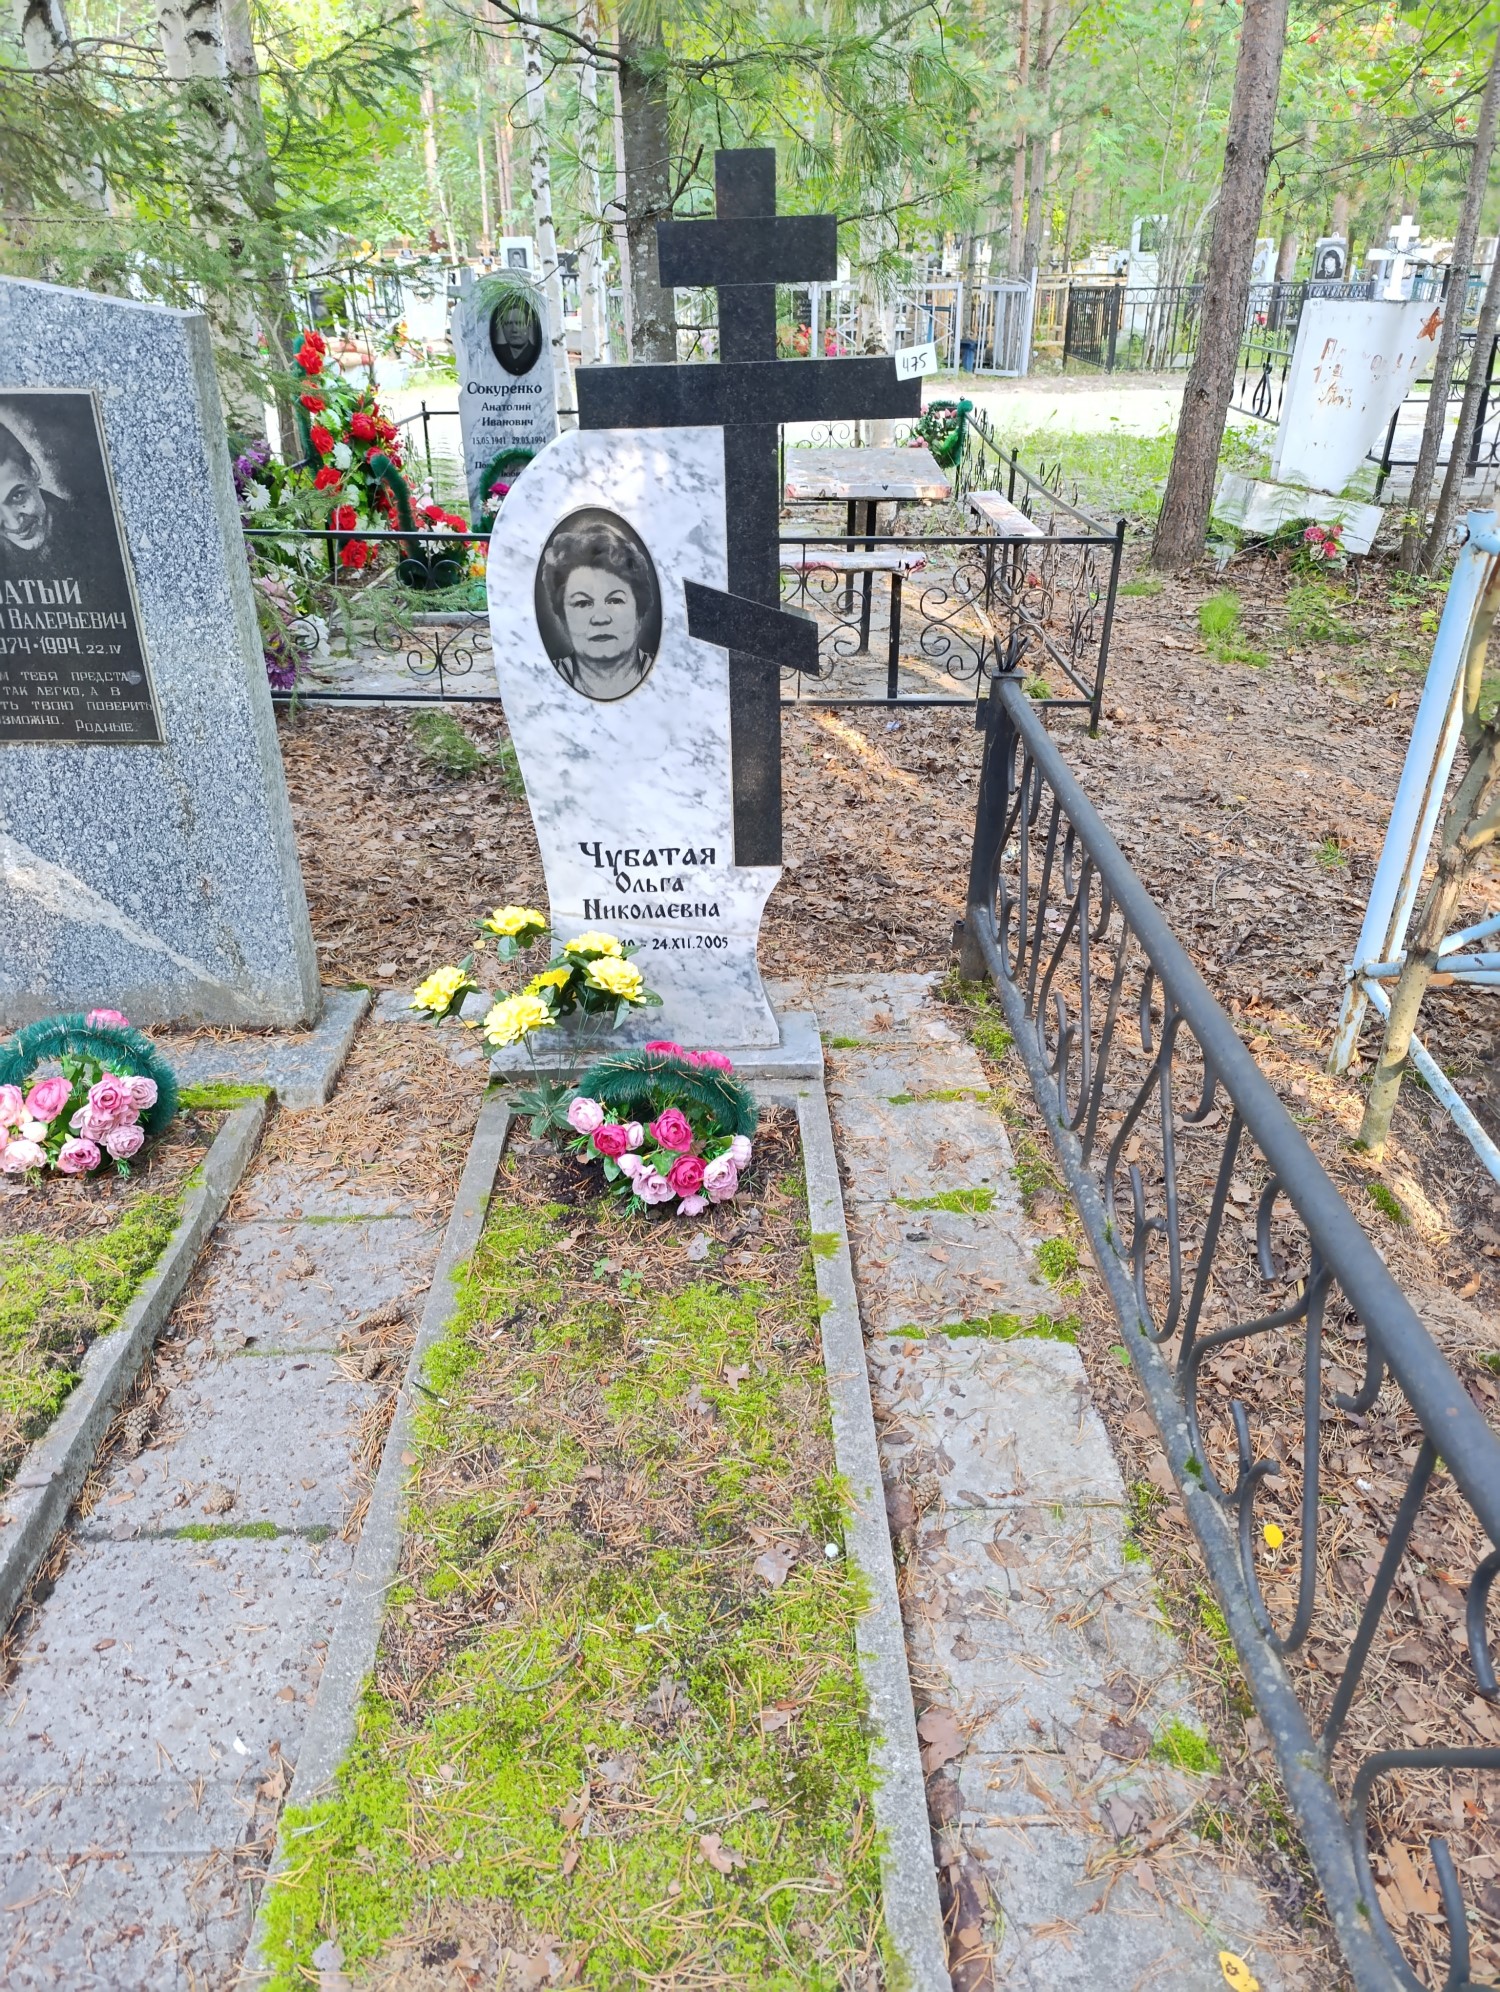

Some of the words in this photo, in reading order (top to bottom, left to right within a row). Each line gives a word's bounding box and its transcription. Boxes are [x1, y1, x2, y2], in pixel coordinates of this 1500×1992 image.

[902, 352, 928, 372] 475
[467, 381, 543, 396] Сокуренко
[481, 402, 532, 411] Анатолий
[482, 417, 534, 426] Иванович
[472, 436, 506, 445] 15.05.1941
[511, 436, 547, 445] 29.03.1994
[0, 577, 83, 604] АТЫЙ
[20, 671, 59, 681] ТЕБЯ
[3, 686, 28, 696] ТАК
[37, 686, 85, 697] ЛЕГКО,
[90, 686, 99, 696] А
[110, 686, 121, 696] В
[31, 701, 74, 711] ТВОЮ
[86, 701, 153, 711] ПОВЕРИТЬ
[578, 841, 716, 876] Чубатая
[615, 871, 684, 893] Ольга
[583, 898, 720, 920] Николаевна
[652, 935, 728, 950] 24.XII.2005
